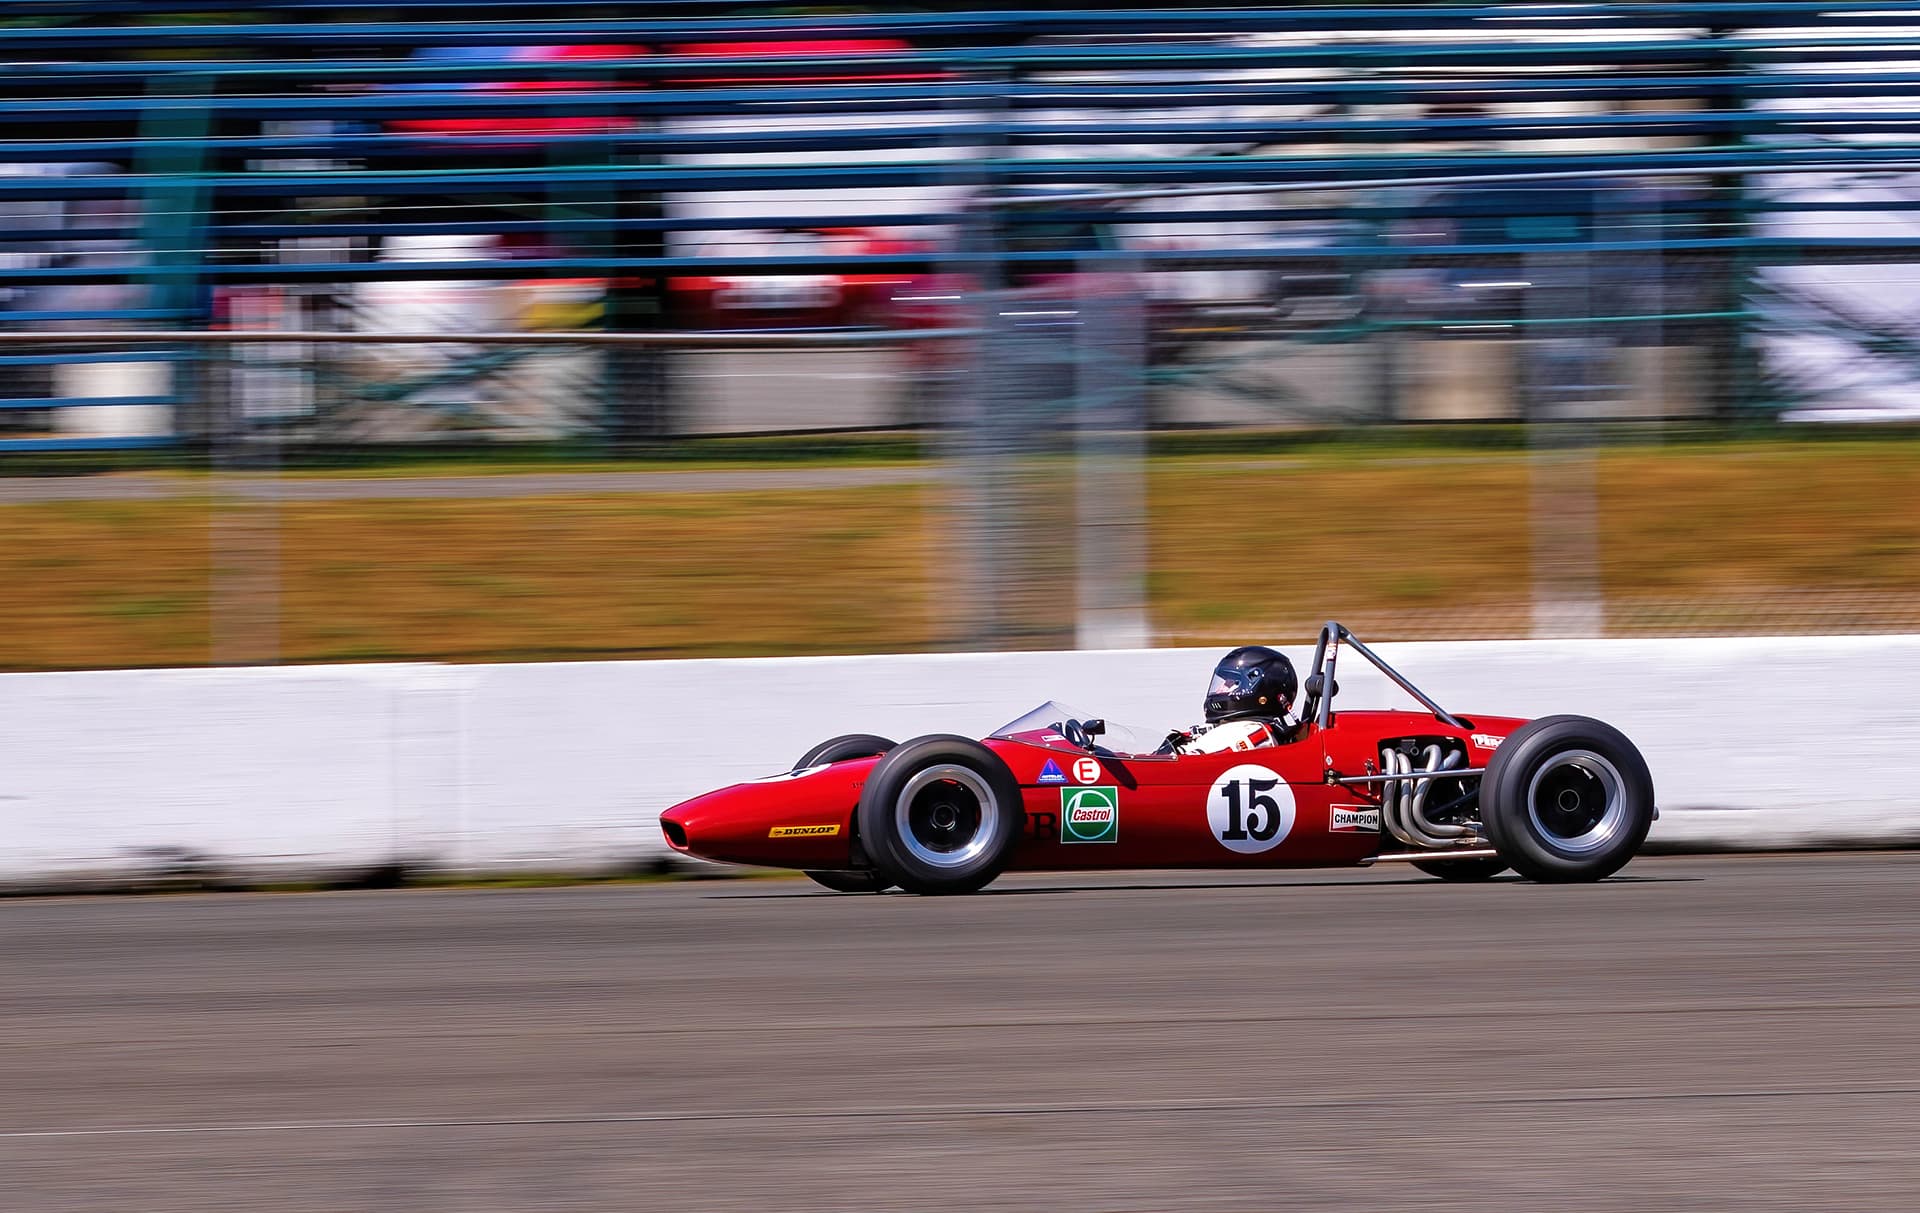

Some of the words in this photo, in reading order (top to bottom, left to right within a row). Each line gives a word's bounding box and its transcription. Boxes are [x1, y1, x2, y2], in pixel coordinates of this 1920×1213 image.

[1078, 760, 1095, 781] E
[1073, 808, 1111, 821] Castrol
[1221, 778, 1281, 841] 15
[1334, 813, 1378, 825] CHAMPION
[783, 826, 835, 835] DUNLOP
